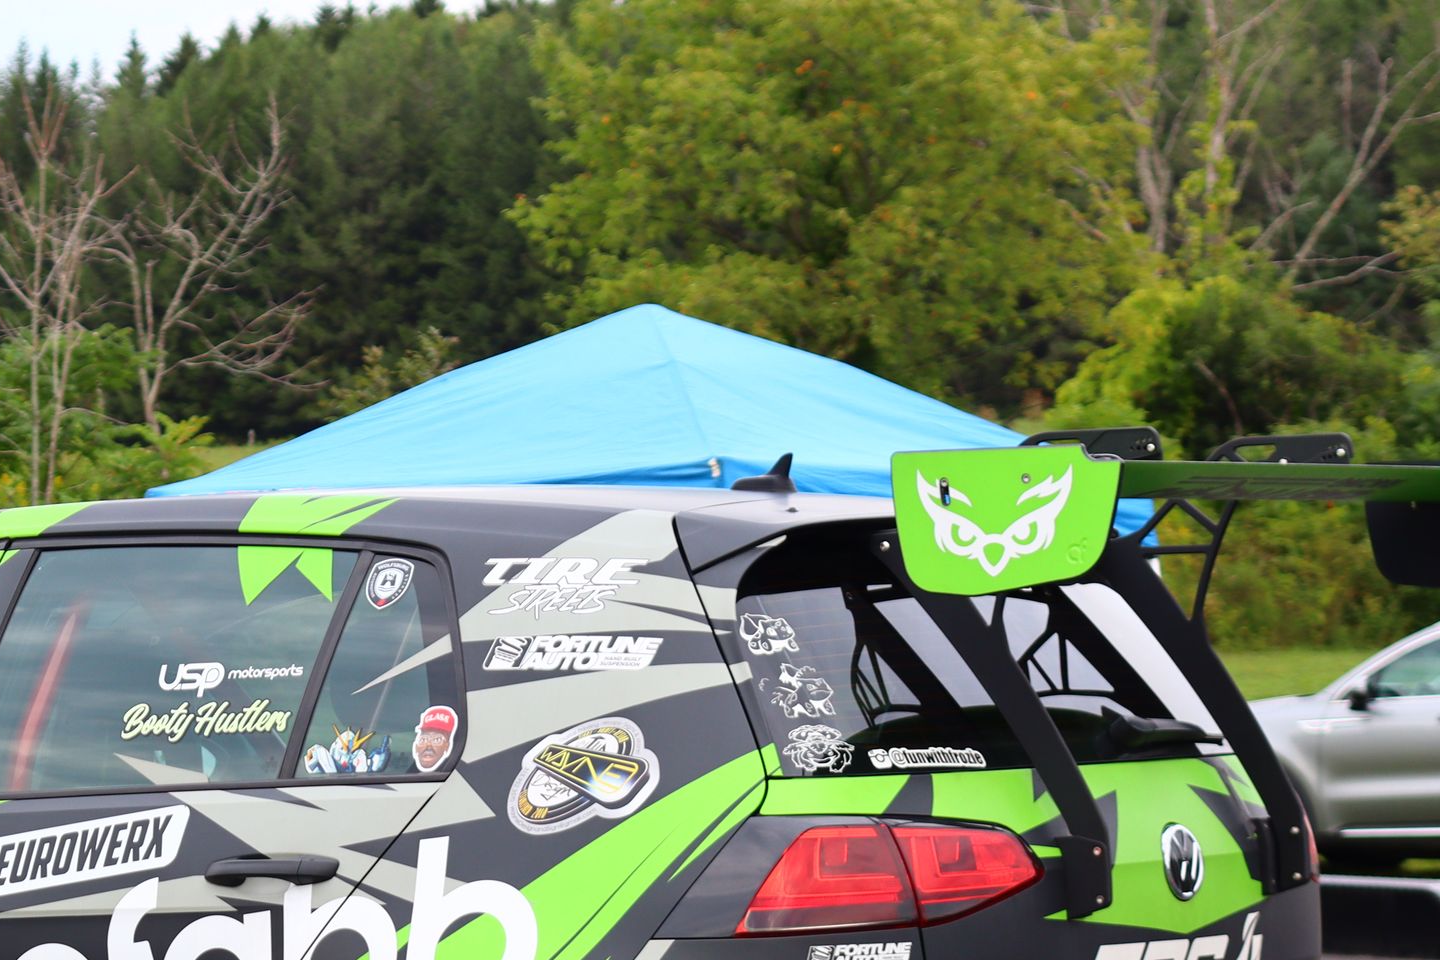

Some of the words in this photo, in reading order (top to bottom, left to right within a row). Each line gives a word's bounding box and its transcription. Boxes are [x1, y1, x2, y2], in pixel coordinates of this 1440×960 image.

[482, 557, 649, 586] TIRE
[487, 584, 620, 620] STREETS
[533, 635, 664, 654] FORTUNE
[522, 652, 597, 671] AUTO
[158, 662, 225, 697] USP
[228, 664, 304, 681] motorsports
[121, 699, 192, 743] Booty
[193, 700, 291, 738] Hustlers
[835, 942, 912, 957] FORTUNE
